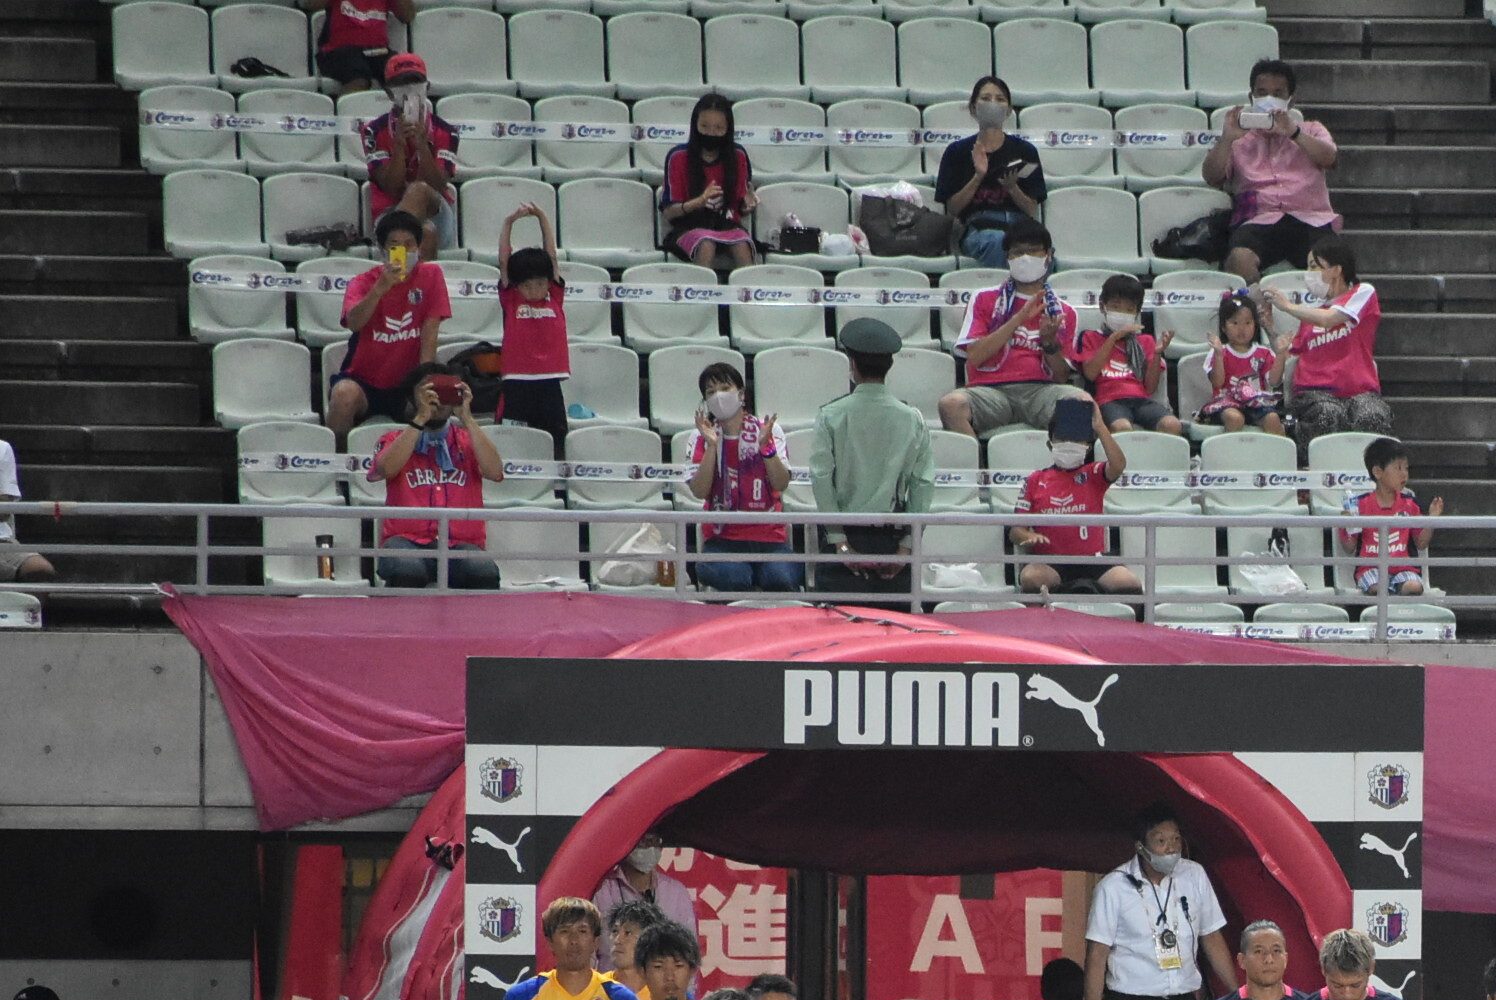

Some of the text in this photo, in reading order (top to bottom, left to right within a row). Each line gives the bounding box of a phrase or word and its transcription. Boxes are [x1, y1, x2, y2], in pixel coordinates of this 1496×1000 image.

[1307, 321, 1353, 350] ANMA
[784, 669, 1020, 747] PUMA
[910, 894, 985, 974] A
